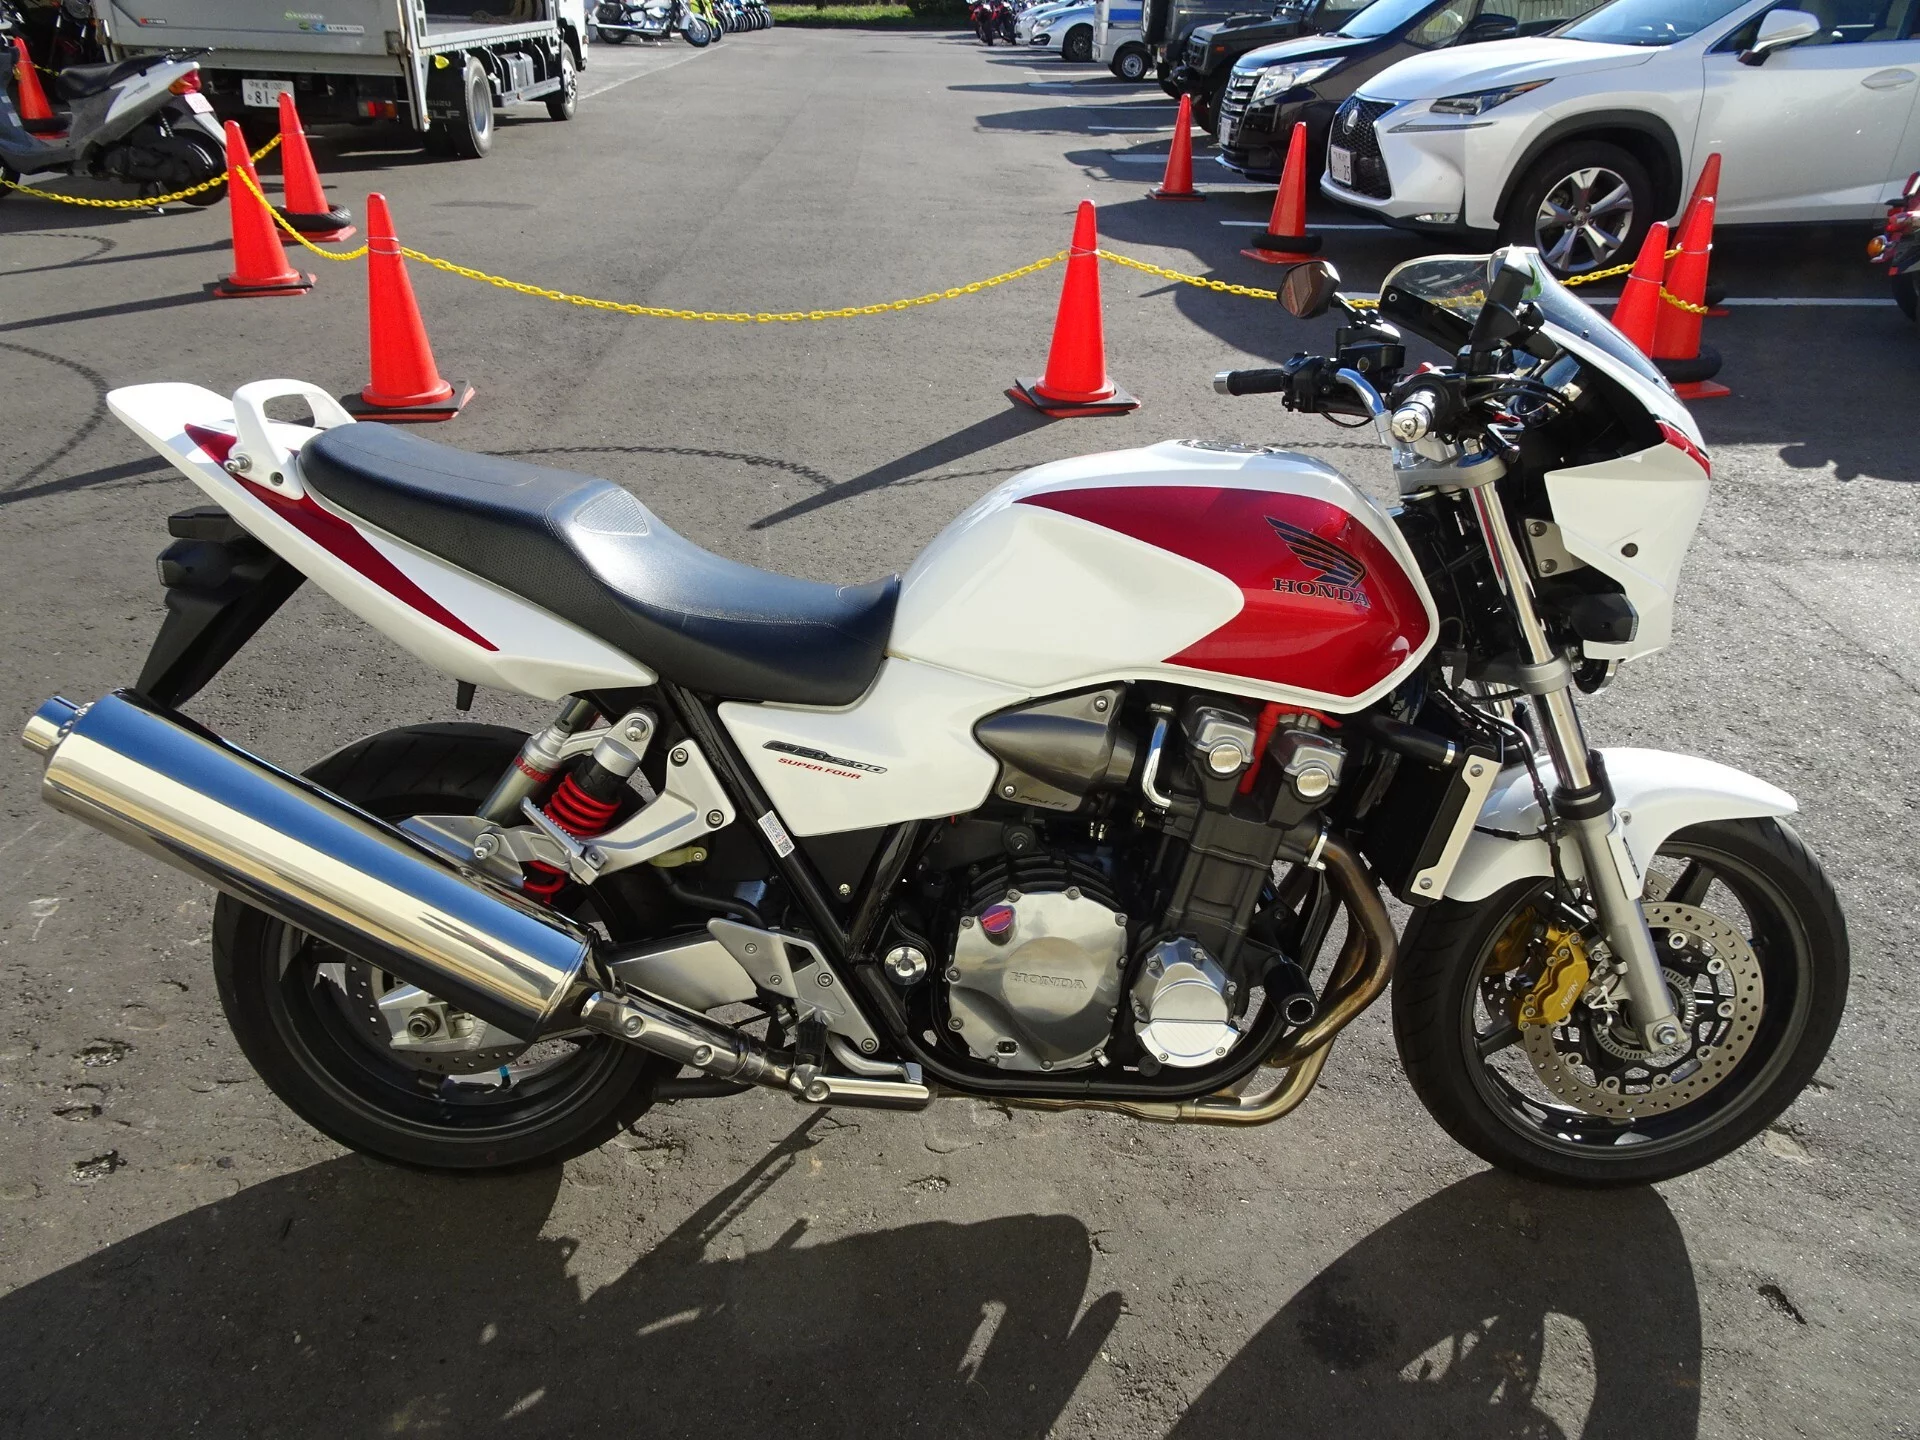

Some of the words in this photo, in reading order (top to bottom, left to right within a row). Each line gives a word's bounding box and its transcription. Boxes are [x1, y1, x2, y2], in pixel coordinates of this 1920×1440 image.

[1273, 578, 1371, 608] HONDA
[778, 758, 824, 771] SUPER
[825, 767, 862, 780] FOUR
[1009, 971, 1087, 989] HONDA
